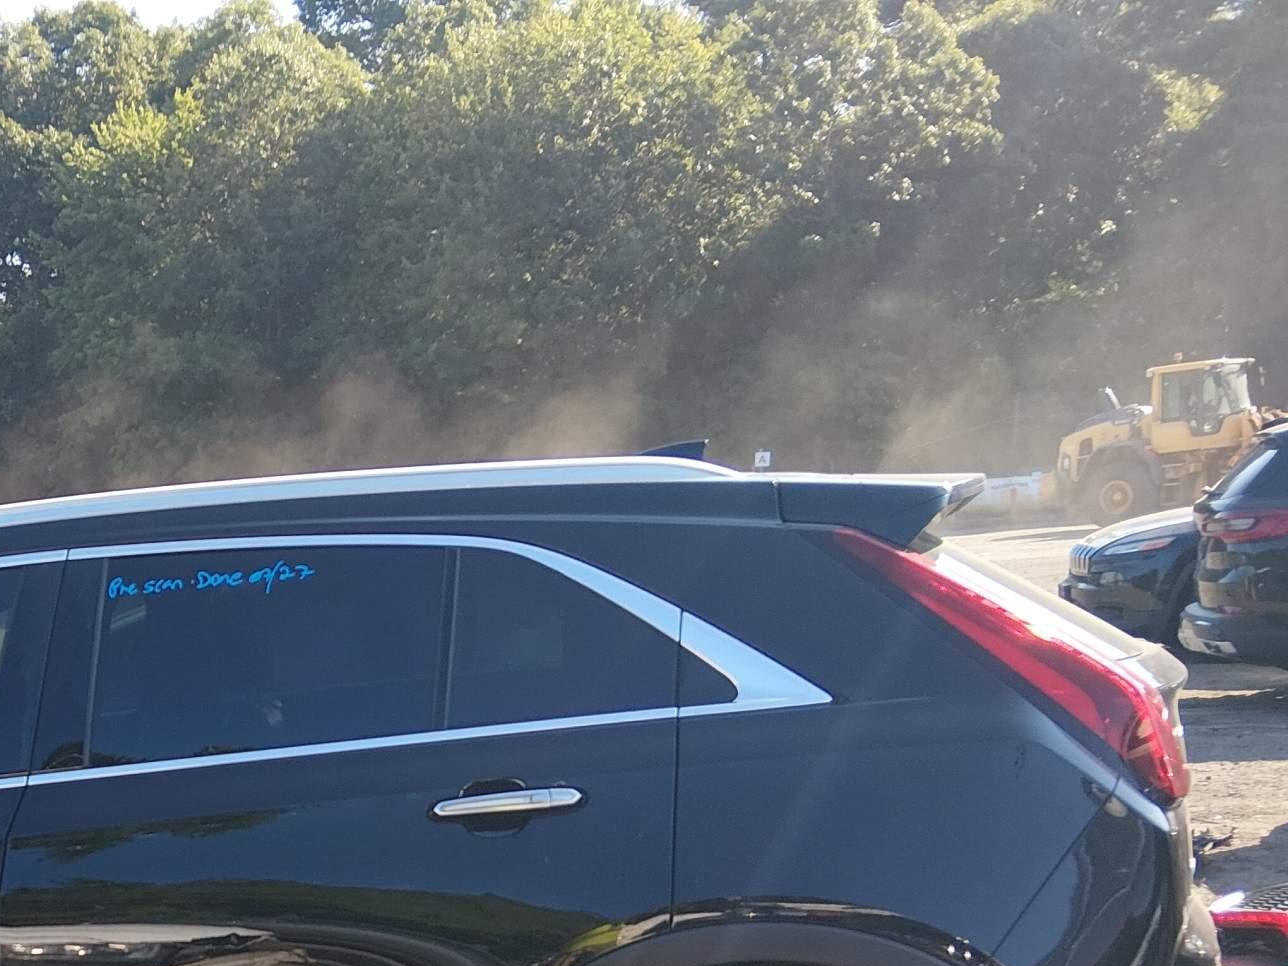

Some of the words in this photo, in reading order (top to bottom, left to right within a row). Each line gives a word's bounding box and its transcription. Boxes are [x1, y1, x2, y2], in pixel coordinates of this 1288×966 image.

[108, 576, 137, 599] Pre
[143, 578, 183, 594] scan
[196, 570, 243, 589] Done
